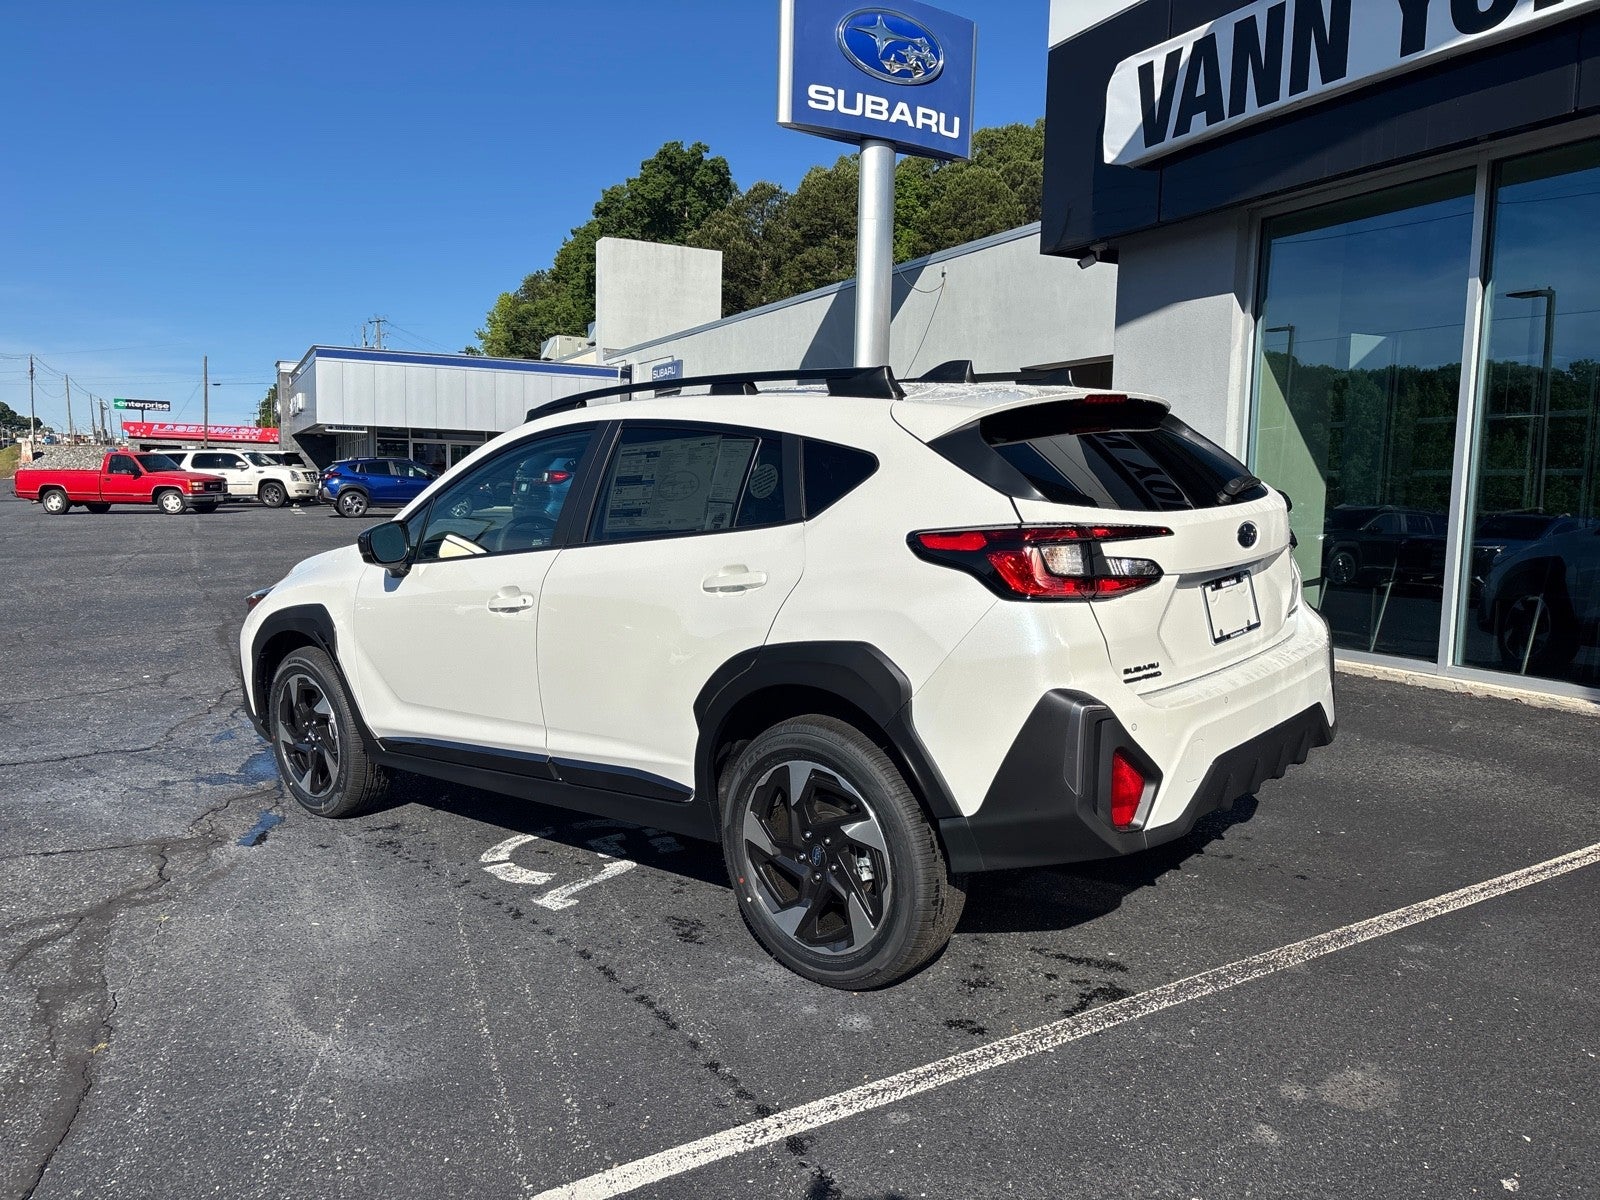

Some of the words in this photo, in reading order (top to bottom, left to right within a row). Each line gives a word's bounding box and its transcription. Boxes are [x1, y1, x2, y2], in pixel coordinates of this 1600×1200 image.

[1137, 0, 1350, 148] VANN
[807, 84, 960, 139] SUBARU
[652, 365, 676, 379] SUBARU
[115, 401, 170, 409] enterprise
[1123, 661, 1159, 675] SUBARU
